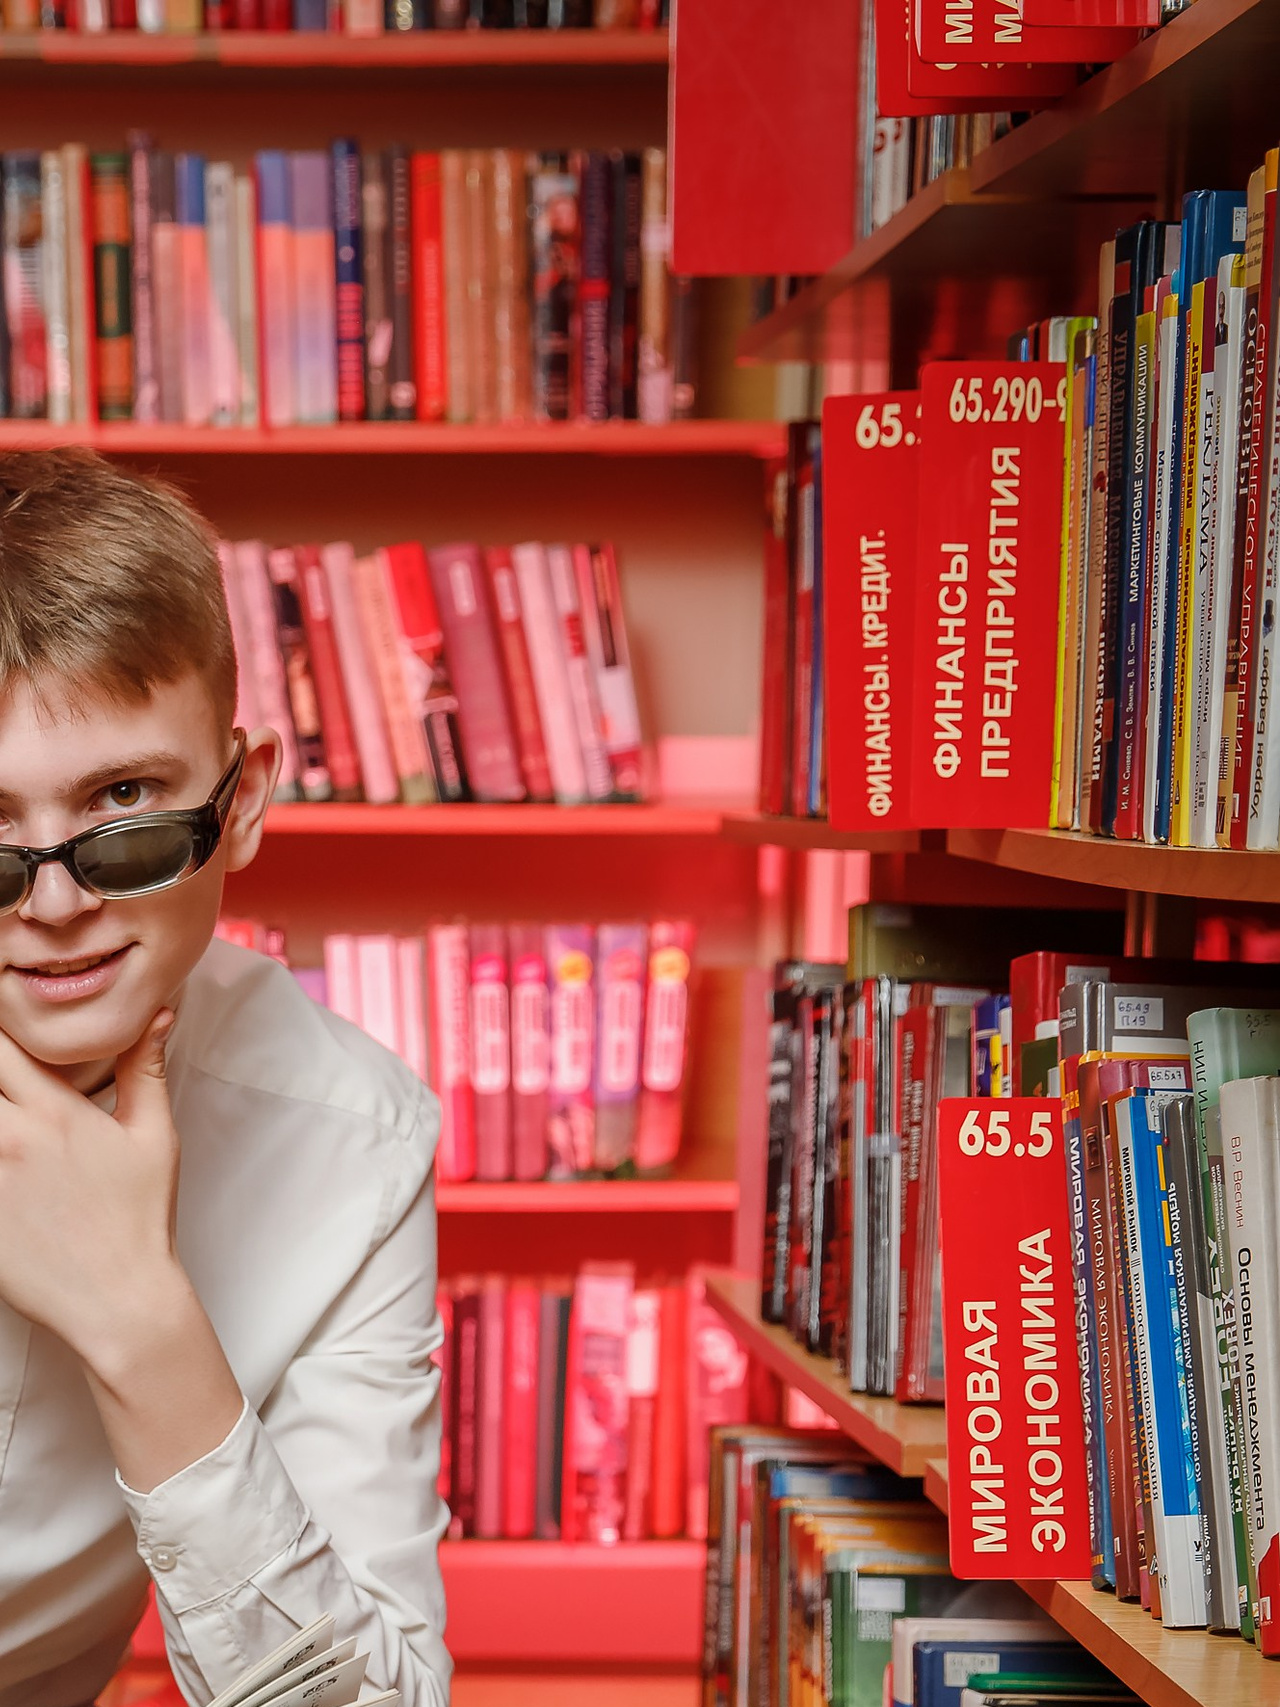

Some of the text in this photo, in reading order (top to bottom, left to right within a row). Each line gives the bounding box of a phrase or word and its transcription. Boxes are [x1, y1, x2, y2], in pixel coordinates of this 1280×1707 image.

[855, 402, 922, 449] 65.
[1239, 307, 1257, 495] ОСНОВЫ
[1129, 343, 1148, 603] МАРКЕТИНГОВЫЕ КОММУНИКАЦИИ
[1155, 450, 1166, 520] Мастер
[1199, 388, 1215, 576] РЕКЛАМА
[1211, 460, 1219, 504] 100%
[1150, 530, 1162, 630] словесной
[1177, 528, 1192, 738] ИННОВАЦИОННЫЙ
[1185, 342, 1201, 509] МЕНЕДЖМЕНТ
[1206, 536, 1217, 621] Маркетинг
[1235, 323, 1266, 768] СТРАТЕГИЧЕСКОЕ УПРАВЛЕНИЕ
[933, 543, 969, 778] ФИНАНСЫ
[981, 447, 1021, 778] ПРЕДПРИЯТИЯ
[1148, 640, 1158, 692] атаки
[1204, 631, 1212, 673] Манн
[860, 529, 893, 817] ФИНАНСЫ. КРЕДИТ.
[1203, 677, 1211, 722] Игорь
[1249, 646, 1270, 818] Уоррен Баффет
[1193, 1040, 1206, 1083] ЛИН
[958, 1110, 1054, 1158] 65.5
[1090, 1198, 1107, 1291] МИРОВАЯ
[1121, 1146, 1139, 1254] МИРОВОЙ РЫНОК
[1231, 1170, 1244, 1228] Веснин
[1069, 1137, 1094, 1444] МИРОВАЯ ЭКОНОМИКА
[1167, 1181, 1202, 1483] КОРПОРАЦИЯ: АМЕРИКАНСКАЯ МОДЕЛЬ
[1221, 1287, 1240, 1379] FOREX
[1018, 1228, 1067, 1554] ЭКОНОМИКА
[1098, 1296, 1115, 1424] ЭКОНОМИКА
[1132, 1272, 1147, 1349] ВОПРОСЫ
[1140, 1350, 1160, 1502] ПРОГНОЗИРОВАНИЯ
[1234, 1383, 1245, 1432] РЫНКЕ
[1237, 1247, 1265, 1531] Основы менеджмента
[962, 1301, 1008, 1553] МИРОВАЯ
[1240, 1448, 1251, 1495] ДЕНЬГИ
[1244, 1497, 1254, 1544] ДЕЛАТЬ
